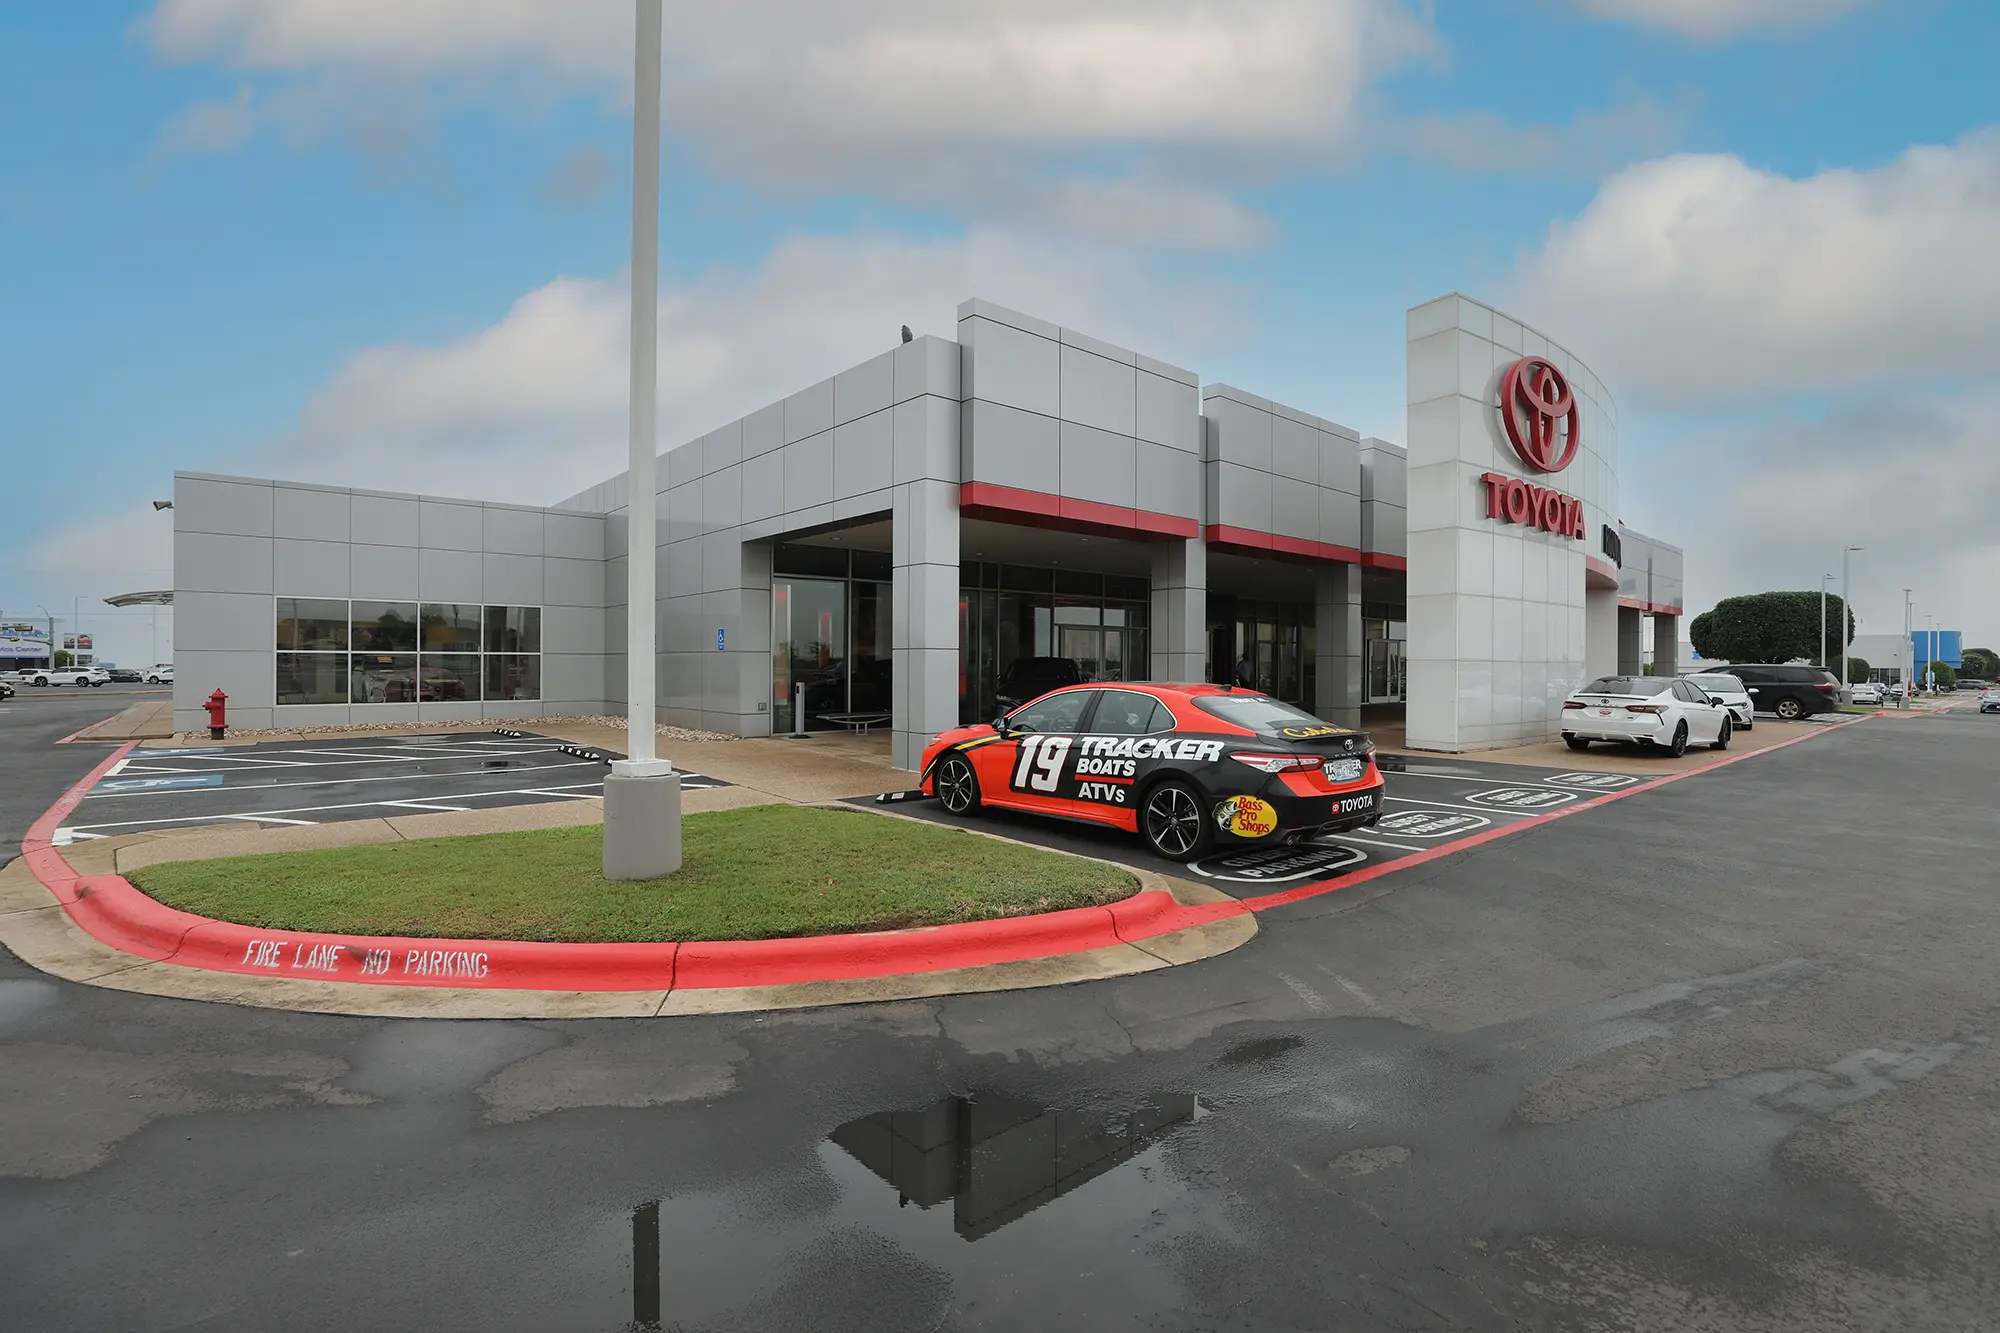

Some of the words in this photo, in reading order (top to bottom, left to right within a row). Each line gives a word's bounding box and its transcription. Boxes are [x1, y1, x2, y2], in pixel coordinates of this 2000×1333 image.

[1480, 472, 1586, 540] TOYOTA
[1080, 736, 1225, 762] TRACKER
[1014, 735, 1073, 792] 19
[1076, 758, 1136, 777] BOATS
[1078, 782, 1126, 803] ATVs
[1238, 797, 1263, 811] Bass
[1340, 795, 1373, 813] TOYOTA
[1238, 809, 1257, 821] Pro
[1238, 819, 1270, 835] Shops
[1236, 850, 1348, 878] PARKING
[241, 940, 288, 967] FIRE
[291, 943, 345, 972] LANE
[361, 949, 392, 975] NO
[404, 950, 488, 978] PARKING
